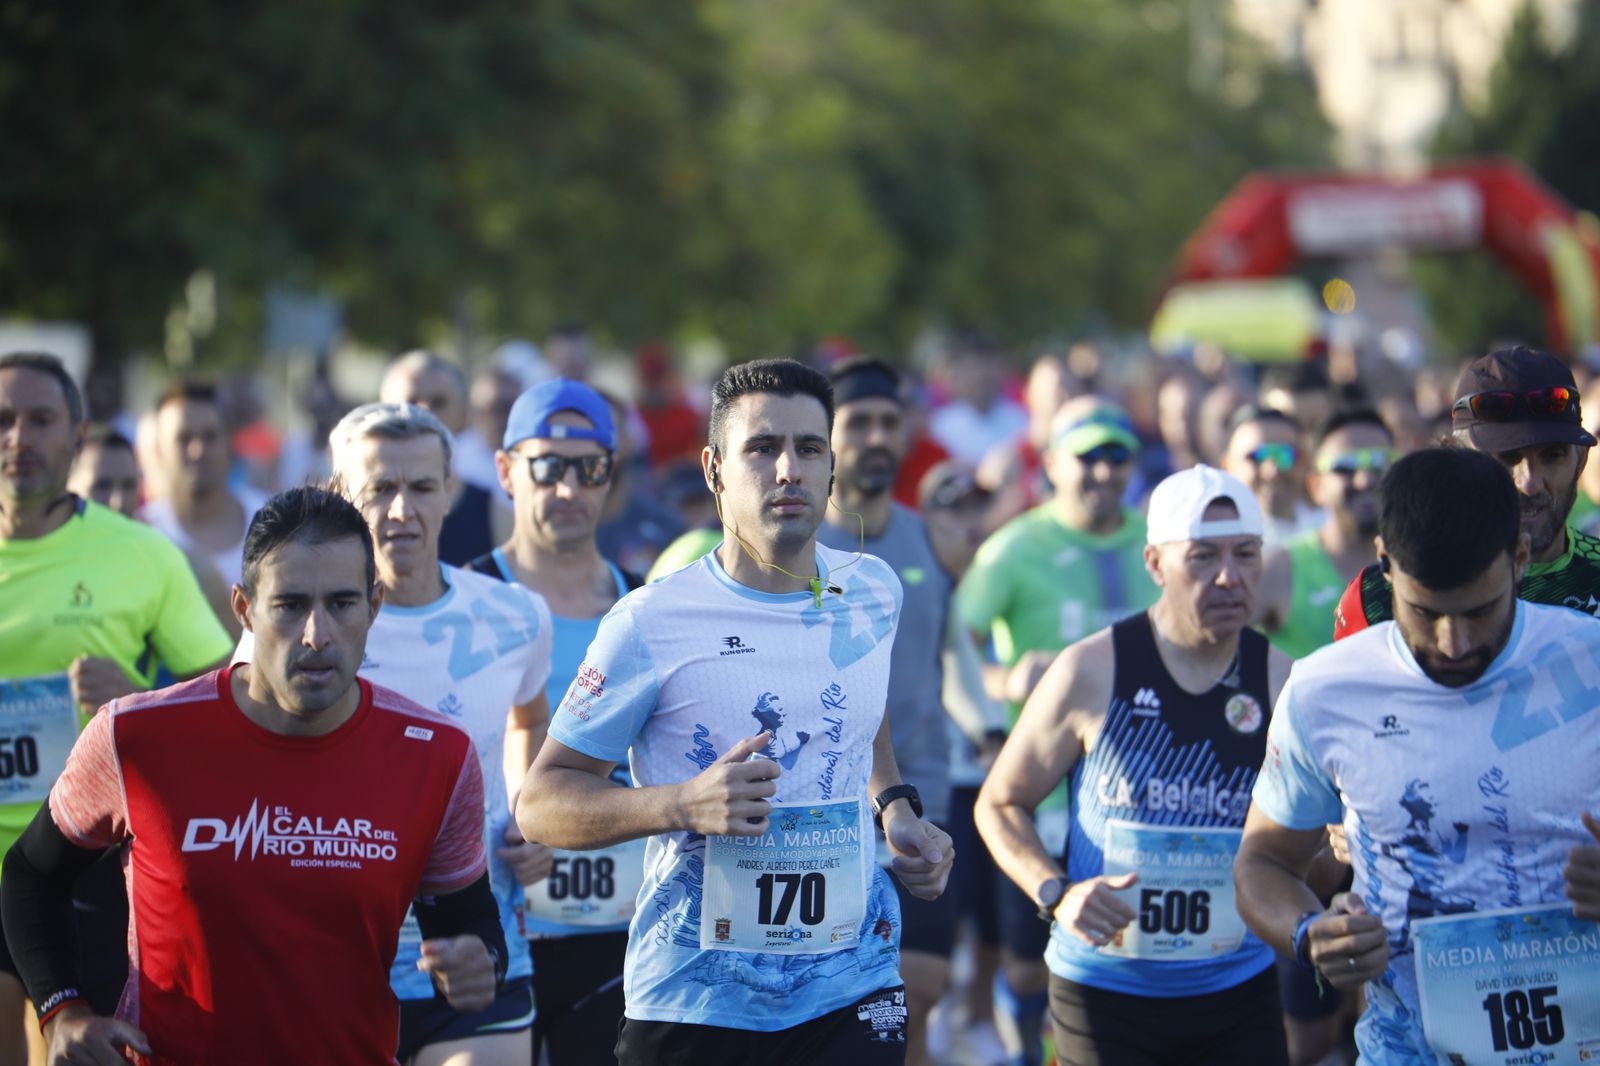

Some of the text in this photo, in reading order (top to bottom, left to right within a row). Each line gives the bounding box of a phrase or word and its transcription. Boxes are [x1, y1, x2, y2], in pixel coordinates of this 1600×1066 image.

[820, 681, 847, 711] Río
[822, 717, 843, 744] del
[275, 806, 292, 816] EL
[273, 816, 398, 841] CALAR DEL
[715, 832, 776, 848] MEDIA
[783, 824, 858, 847] MARATÓN
[263, 840, 397, 861] RIO MUNDO
[1167, 848, 1234, 868] MARATÓ
[290, 858, 362, 869] EDICIÓN ESPECIAL
[736, 859, 764, 871] ANDRES
[766, 860, 797, 872] ALBERTO
[799, 859, 818, 871] PEREZ
[548, 857, 615, 900] 508
[756, 872, 826, 926] 170
[1139, 888, 1211, 935] 506
[765, 927, 812, 939] serizona
[1427, 946, 1496, 968] MEDIA
[1503, 931, 1598, 961] MARATÓN
[1475, 978, 1500, 991] DAVID
[1482, 985, 1565, 1053] 185
